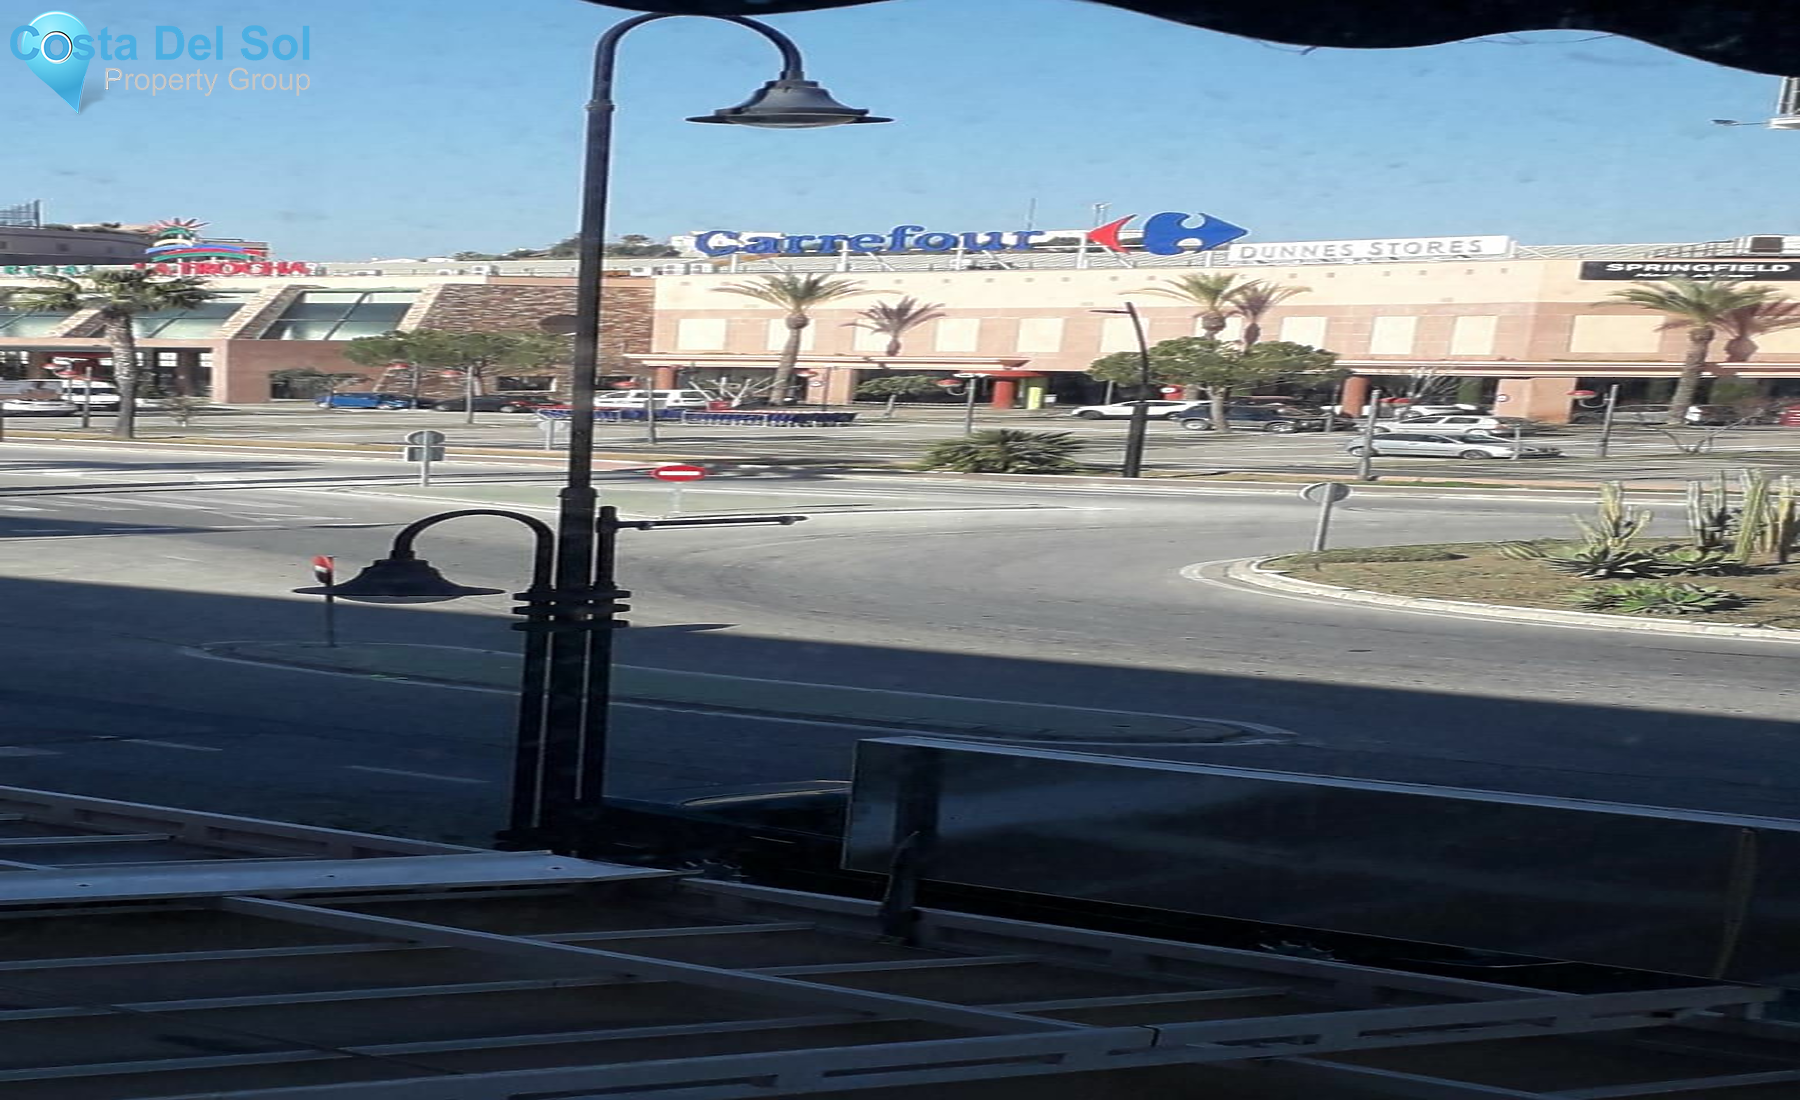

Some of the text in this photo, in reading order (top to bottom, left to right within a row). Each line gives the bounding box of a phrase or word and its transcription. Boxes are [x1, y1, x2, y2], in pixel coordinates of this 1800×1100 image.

[695, 225, 1046, 257] Carrefour
[1239, 239, 1483, 260] DUNNES STORES
[1606, 263, 1791, 272] SPRINGFIELD
